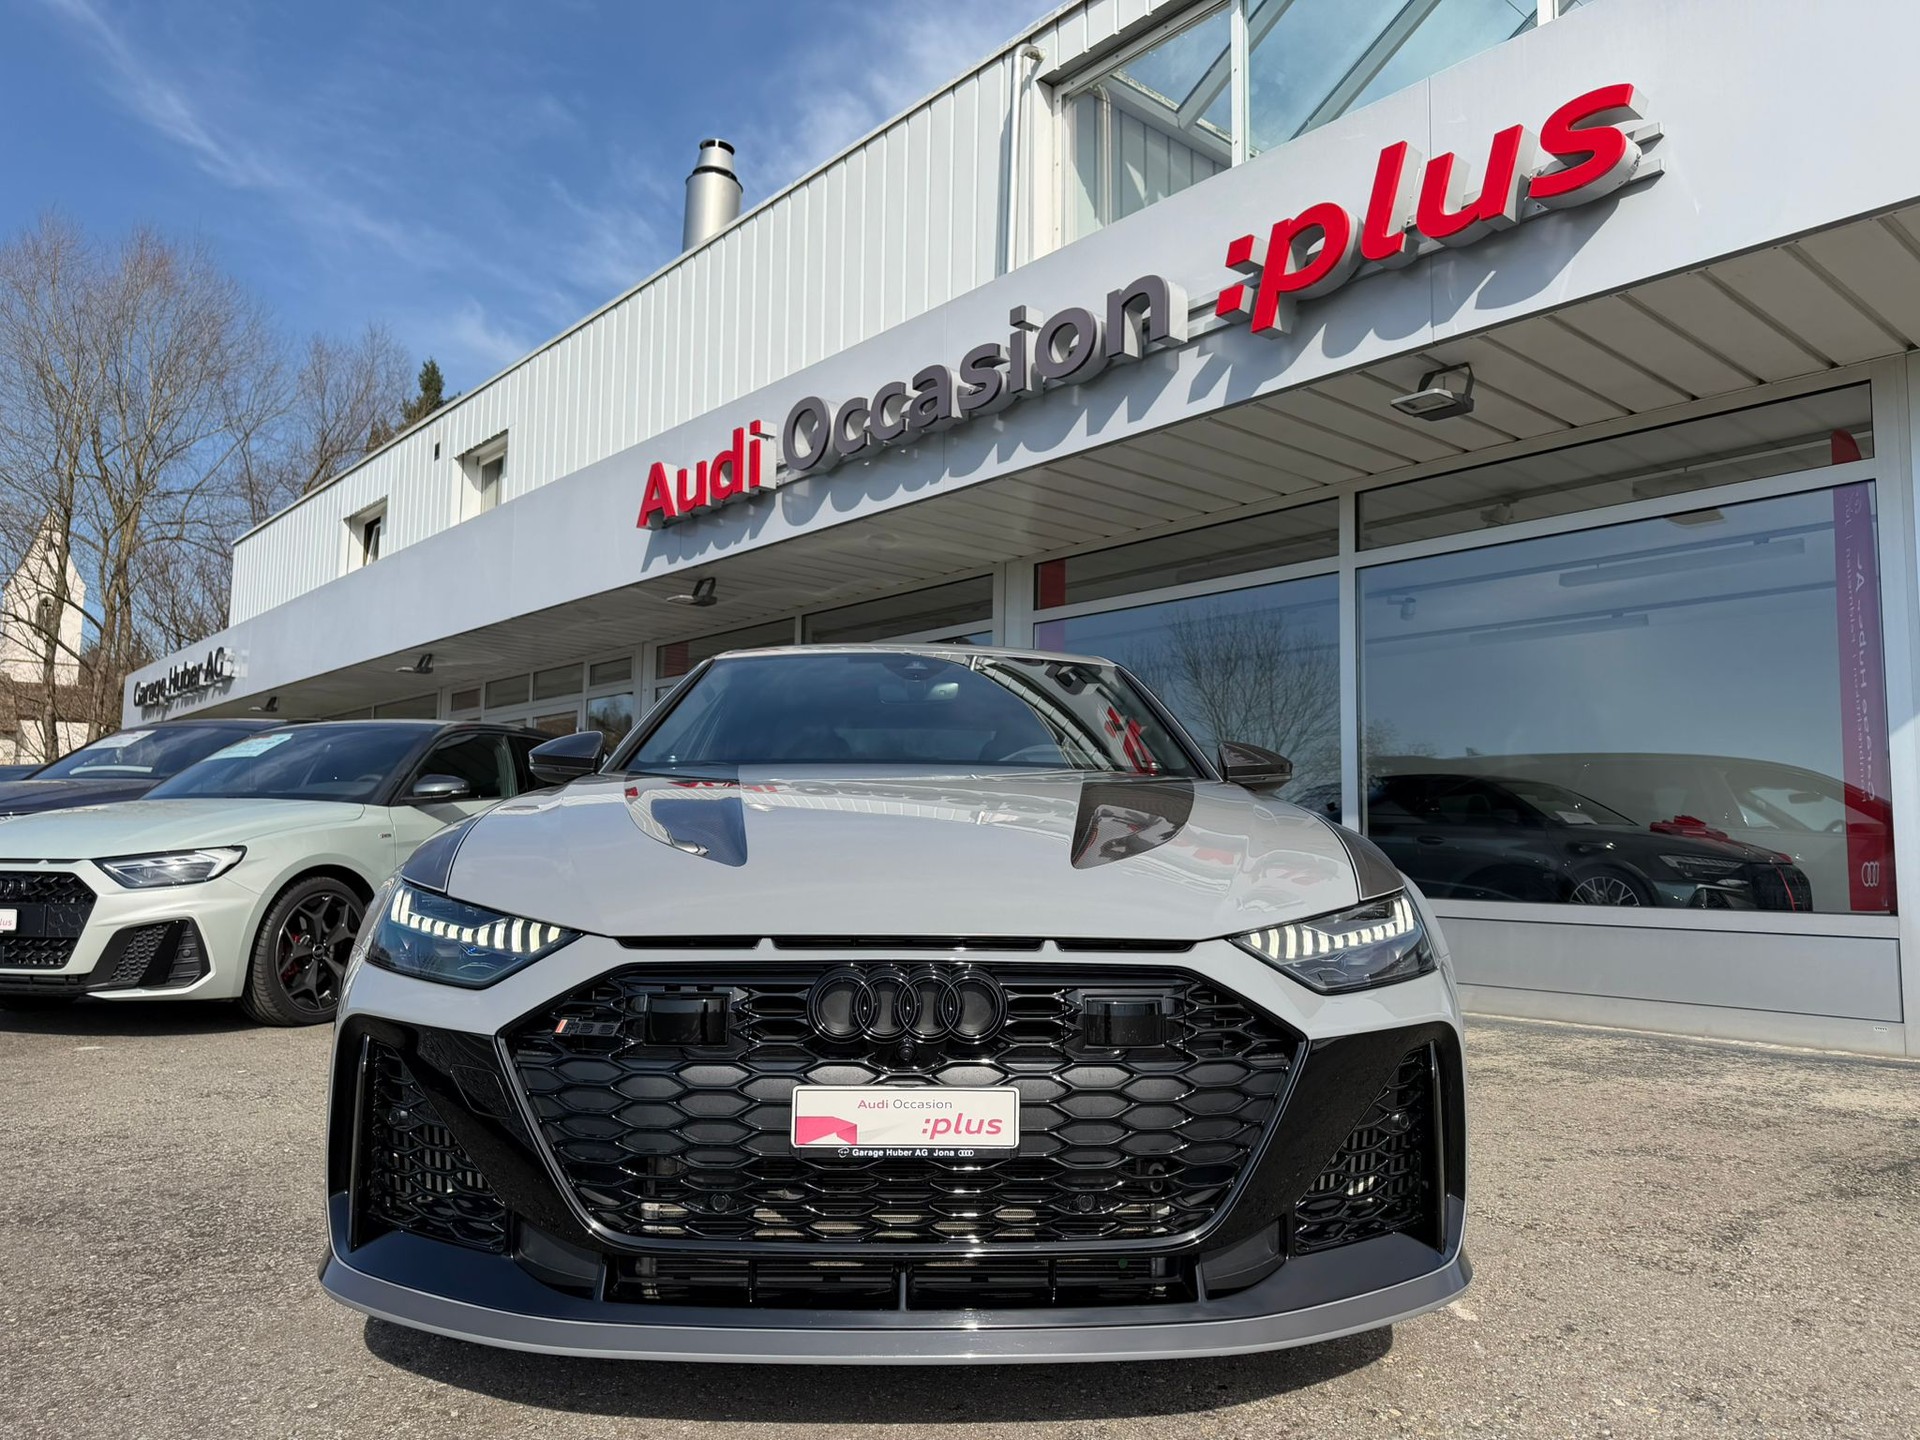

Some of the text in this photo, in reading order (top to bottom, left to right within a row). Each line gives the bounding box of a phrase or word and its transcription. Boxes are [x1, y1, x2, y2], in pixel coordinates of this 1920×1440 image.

[637, 83, 1636, 528] Audi Occasion :plus
[134, 646, 224, 706] Garage Huber AG
[857, 1099, 953, 1109] Audi Occasion
[921, 1113, 1003, 1140] :plus
[852, 1149, 955, 1159] Garage Huber AG Jona
